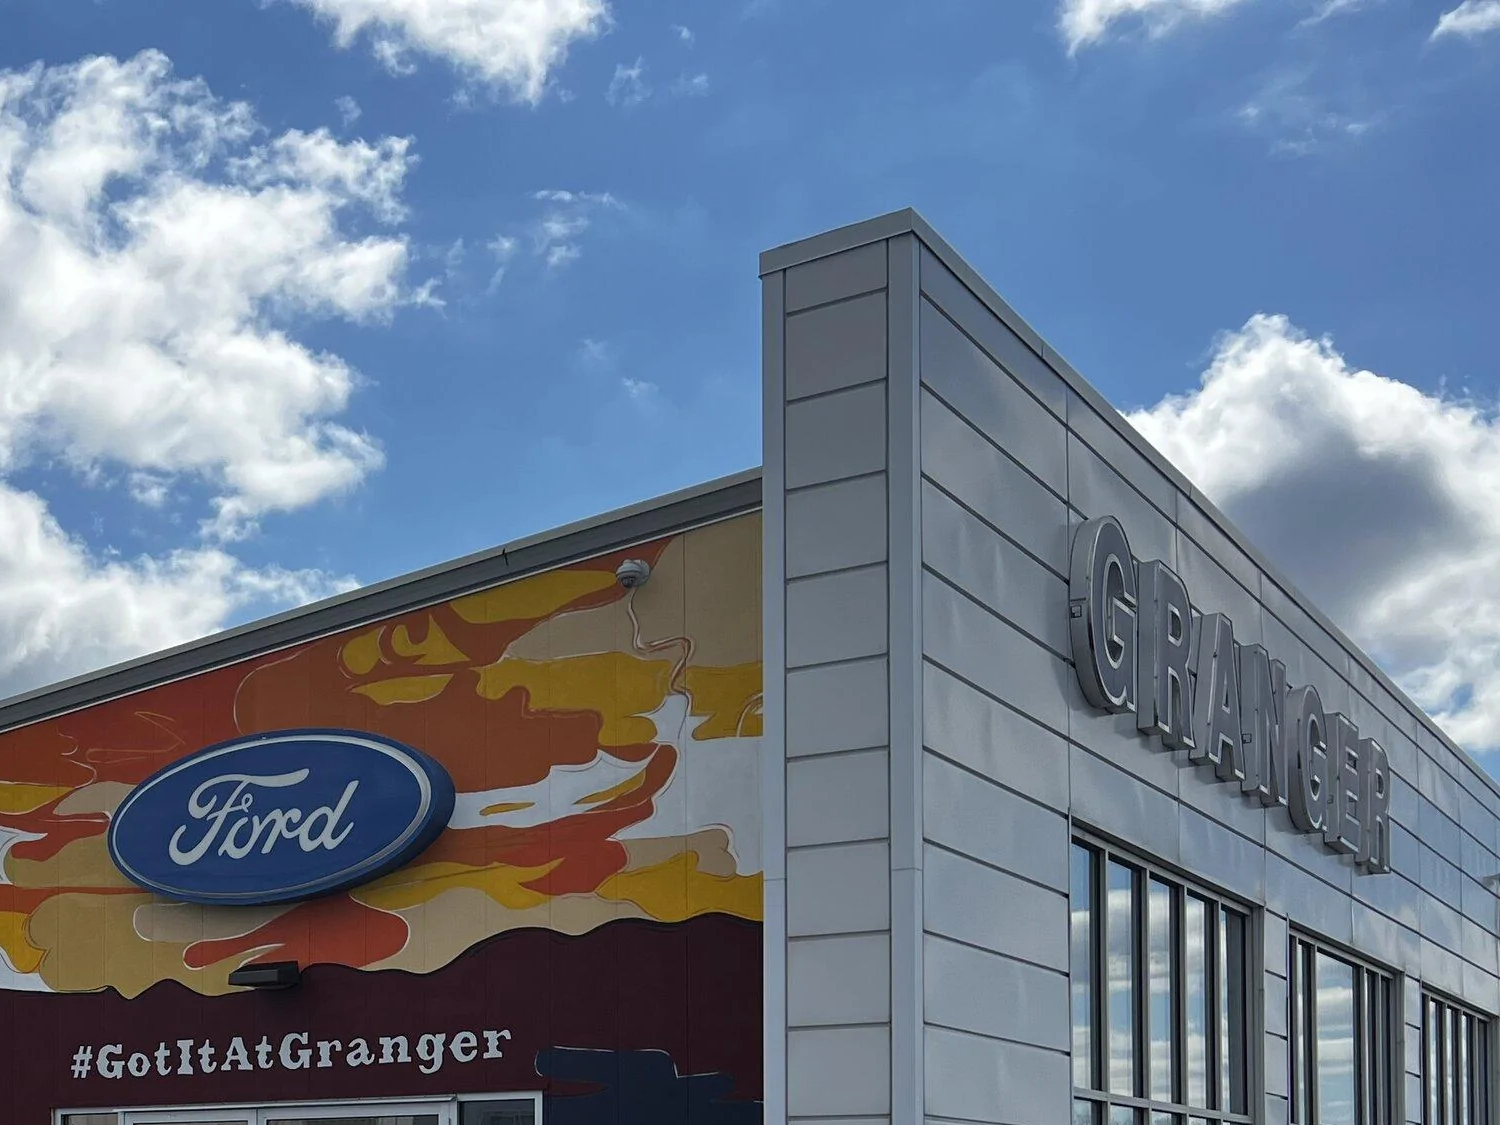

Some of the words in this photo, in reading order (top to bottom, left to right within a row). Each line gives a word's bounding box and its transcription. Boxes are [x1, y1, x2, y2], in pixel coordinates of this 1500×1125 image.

[1070, 515, 1391, 874] GRANGER
[168, 767, 359, 867] Ford
[70, 1028, 513, 1080] #GotItAtGranger
